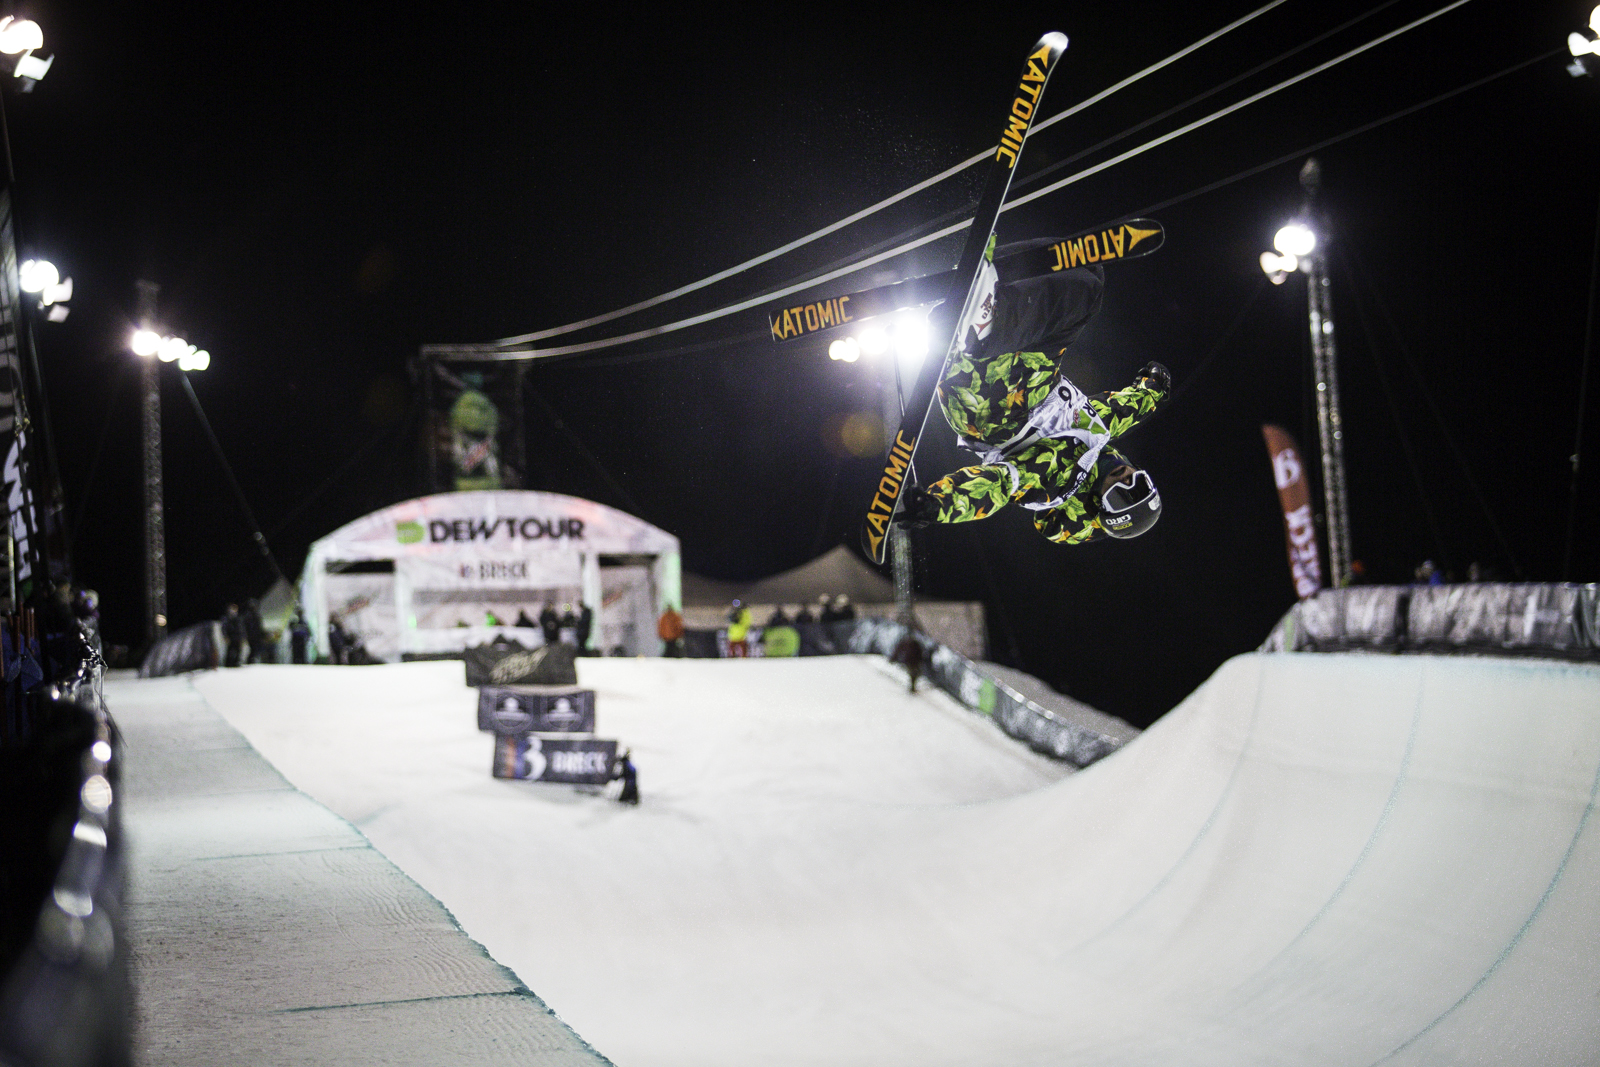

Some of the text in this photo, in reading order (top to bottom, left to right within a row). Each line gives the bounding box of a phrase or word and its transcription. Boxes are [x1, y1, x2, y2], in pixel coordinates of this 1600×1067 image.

[996, 60, 1046, 169] ATOMIC
[1048, 225, 1124, 272] ATOMIC
[783, 295, 854, 340] ATOMIC
[866, 429, 916, 536] ATOMIC
[1105, 514, 1132, 526] GIRO
